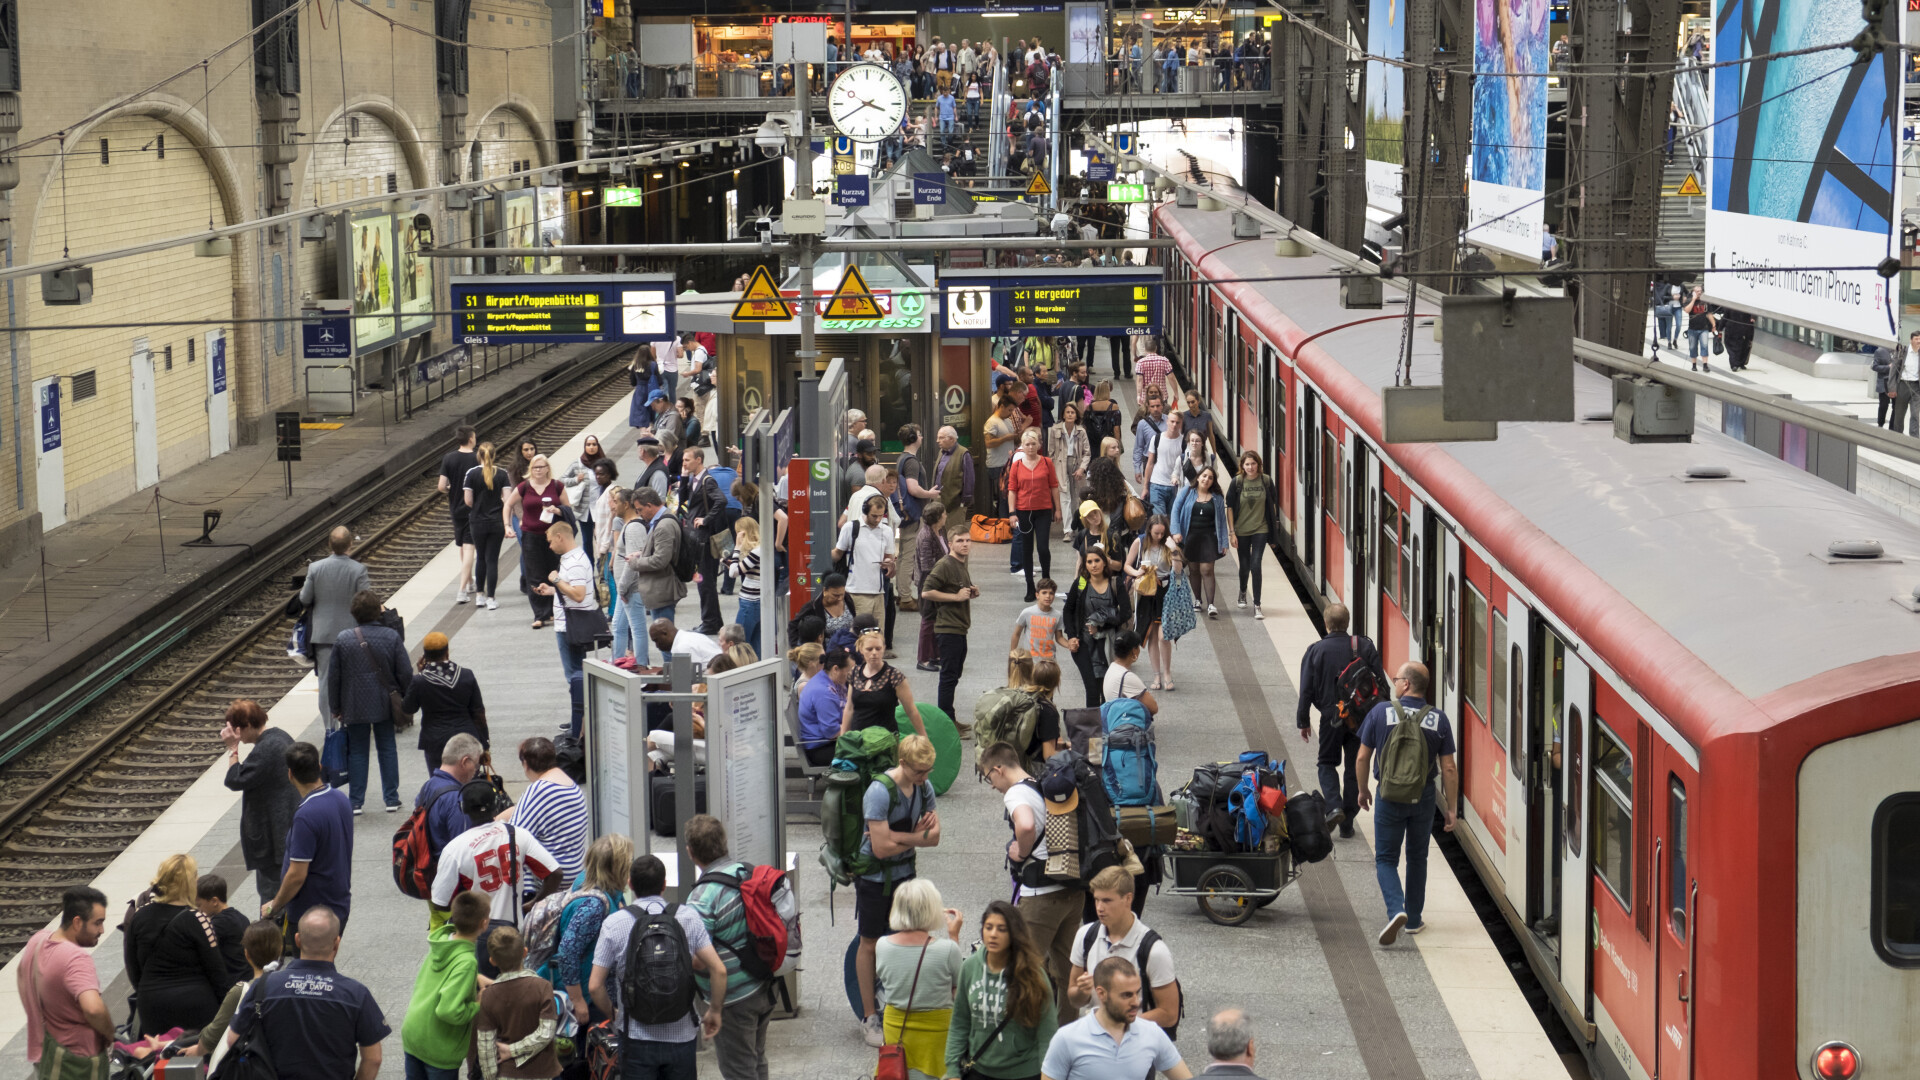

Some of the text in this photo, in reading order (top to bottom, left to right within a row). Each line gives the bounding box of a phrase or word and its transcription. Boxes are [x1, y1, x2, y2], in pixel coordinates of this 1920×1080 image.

[763, 16, 832, 25] LE CROBAG
[1118, 134, 1132, 154] U
[1732, 252, 1861, 305] Fotografiert mit dem iPhone
[466, 296, 477, 306] S1
[486, 294, 584, 308] Airport/Poppenbüttel
[1014, 288, 1030, 299] S21
[1034, 288, 1080, 301] Bergedorf
[820, 314, 925, 332] express
[1126, 328, 1151, 336] Gleis 4
[815, 460, 830, 479] S
[1030, 615, 1056, 628] GOALS
[1030, 639, 1055, 657] LIE
[474, 844, 520, 892] 56
[1600, 928, 1611, 958] Bahn
[1610, 942, 1631, 989] Hamburg
[285, 982, 333, 992] CAMP DAVID
